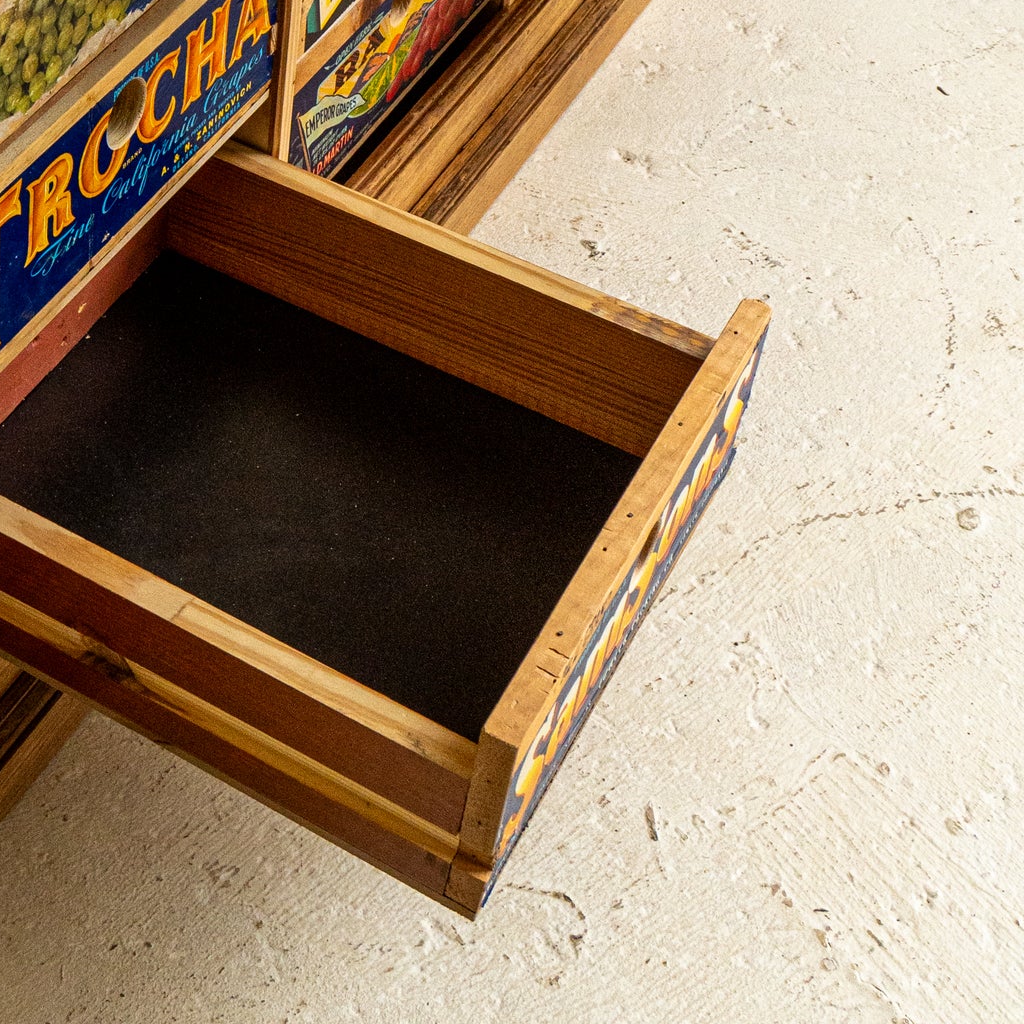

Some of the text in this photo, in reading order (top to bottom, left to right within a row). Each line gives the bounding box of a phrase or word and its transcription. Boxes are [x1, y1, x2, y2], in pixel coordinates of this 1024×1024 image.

[196, 81, 252, 142] ZANINOVICH
[305, 95, 357, 139] EMPEROR GRAPES
[31, 214, 95, 277] Fine
[102, 111, 198, 215] California
[203, 45, 263, 114] Grapes
[122, 147, 143, 170] BRAND
[324, 126, 355, 168] MARTIN
